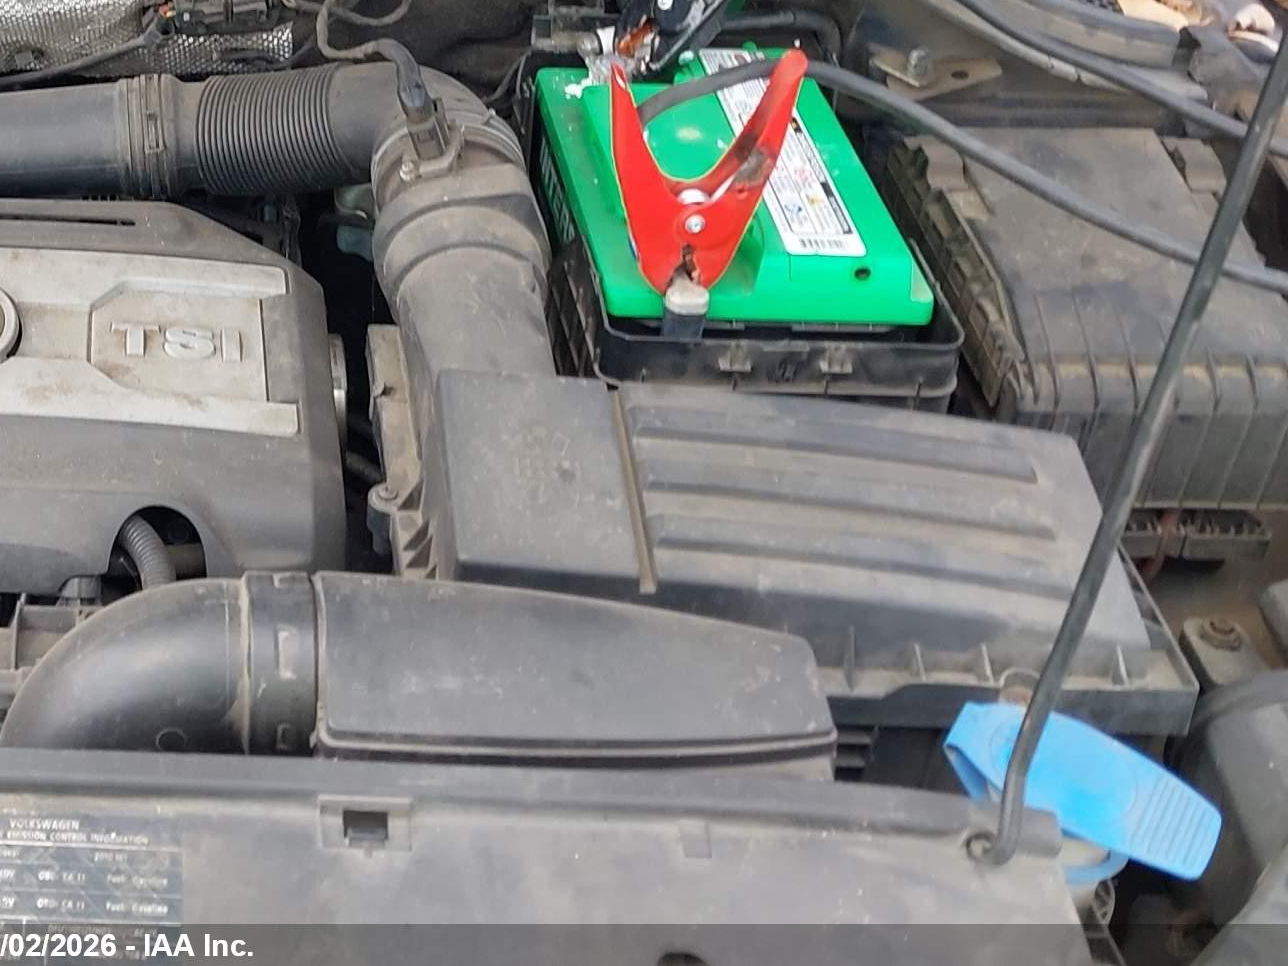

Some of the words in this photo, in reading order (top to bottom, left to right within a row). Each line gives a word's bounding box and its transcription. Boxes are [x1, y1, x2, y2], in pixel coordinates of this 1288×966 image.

[111, 322, 243, 363] TSI
[9, 818, 80, 830] VOLKSWAGEN
[49, 831, 87, 842] CONTROL
